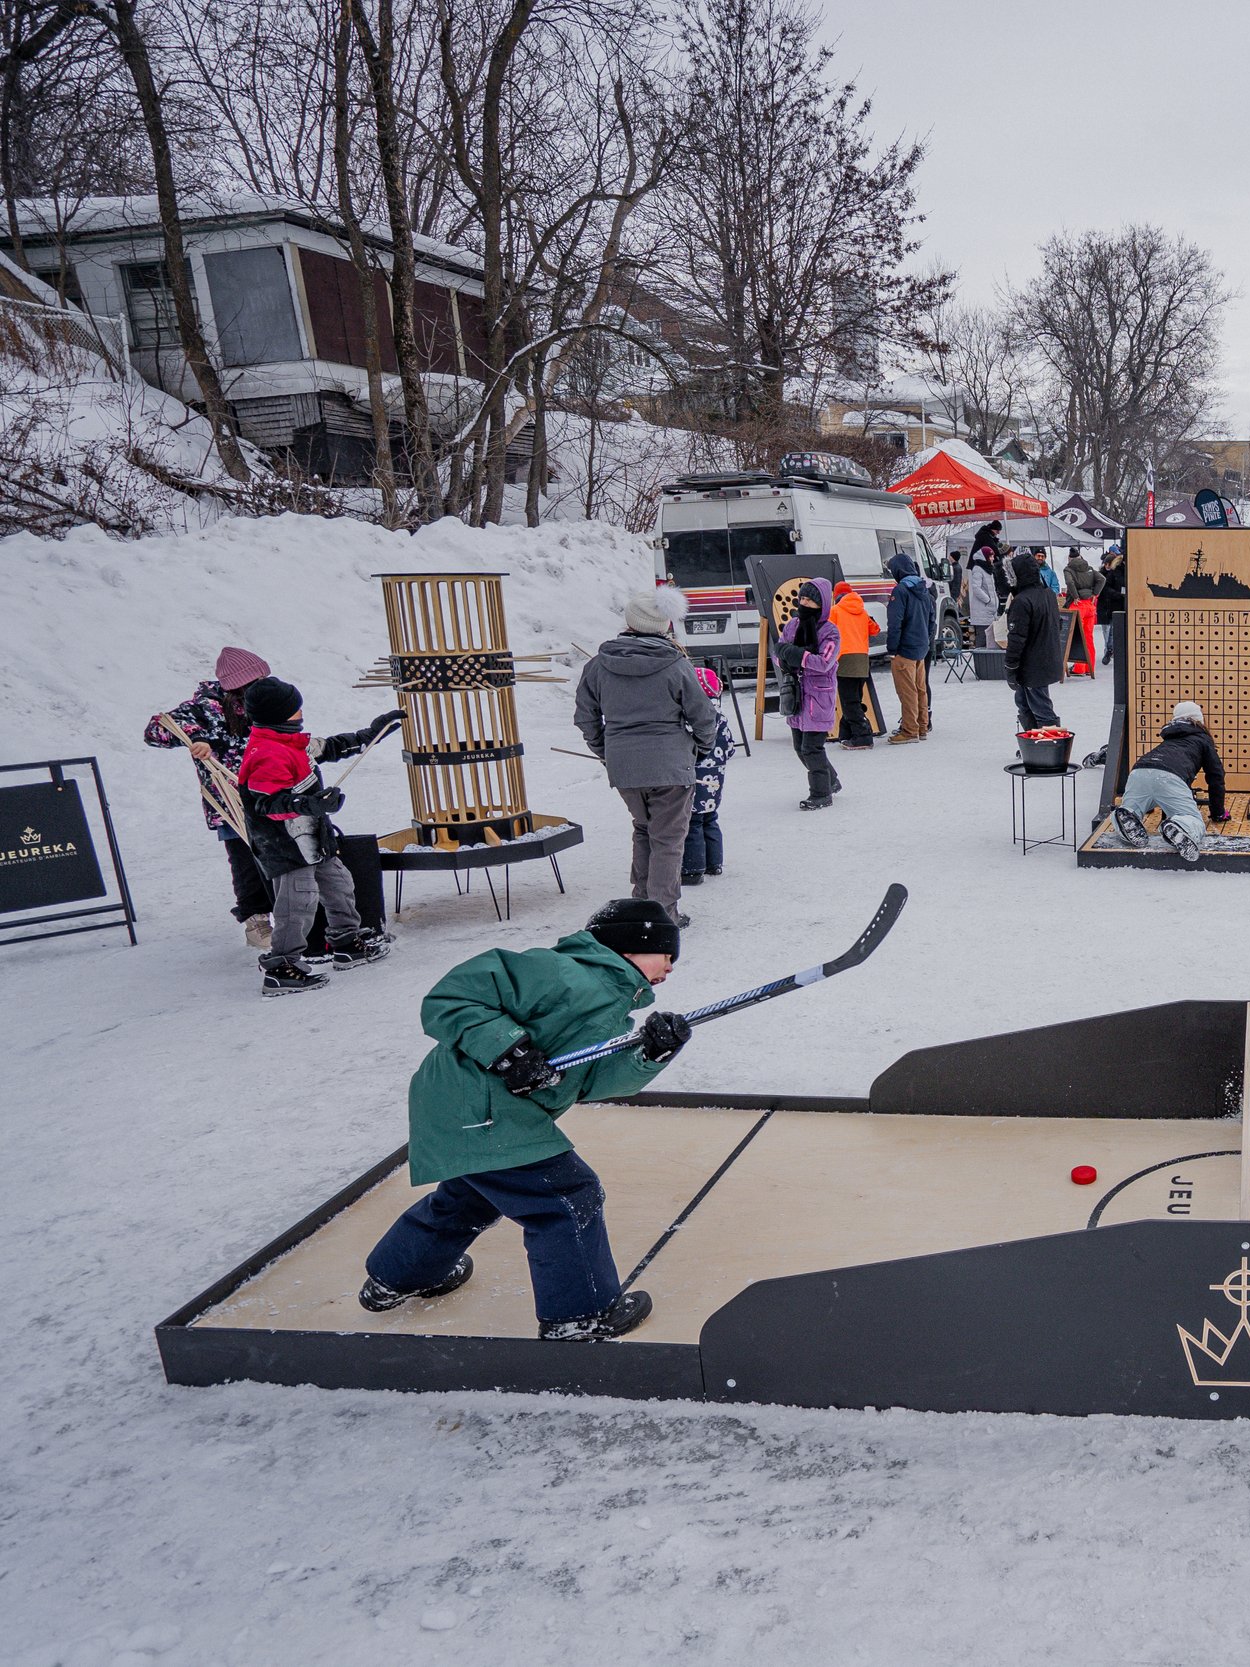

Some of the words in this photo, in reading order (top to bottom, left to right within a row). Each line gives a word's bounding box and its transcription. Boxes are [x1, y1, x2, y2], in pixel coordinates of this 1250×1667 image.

[917, 498, 976, 515] TARIEU
[1201, 500, 1220, 512] TEMPS
[1203, 511, 1222, 523] PINTE
[1155, 612, 1160, 623] 1
[1169, 612, 1175, 623] 2
[1183, 612, 1190, 623] 3
[1198, 612, 1204, 623] 4
[1213, 612, 1220, 624] 5
[1228, 612, 1234, 624] 6
[1242, 613, 1249, 624] 7
[1139, 627, 1146, 638] A
[1140, 642, 1146, 653] B
[1140, 656, 1146, 668] C
[1140, 671, 1146, 683] D
[1140, 686, 1146, 697] E
[1141, 700, 1146, 711] F
[1140, 715, 1146, 726] G
[1140, 729, 1147, 741] H
[0, 842, 76, 861] JEUREKA
[40, 851, 78, 860] D'AMBIANCE
[1166, 1175, 1193, 1215] JEU
